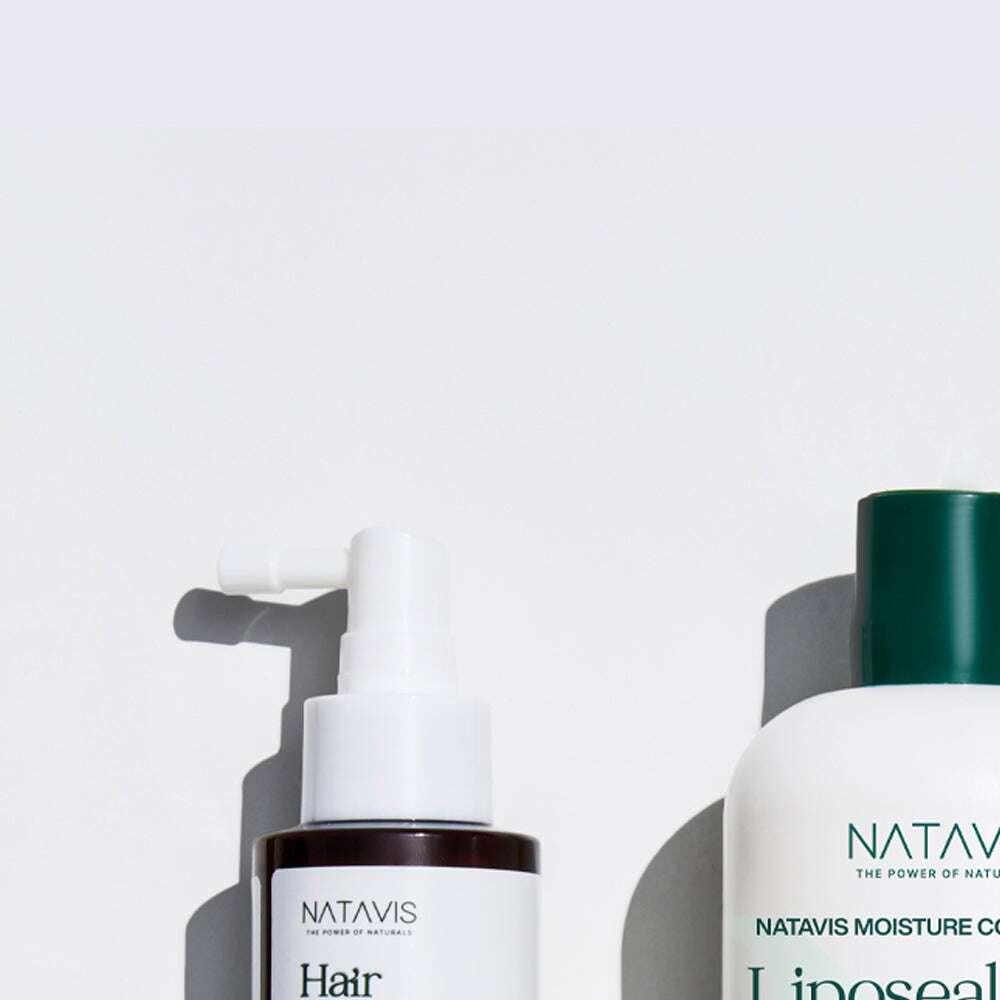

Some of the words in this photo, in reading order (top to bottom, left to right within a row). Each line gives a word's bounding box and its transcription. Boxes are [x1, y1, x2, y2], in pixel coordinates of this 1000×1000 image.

[856, 868, 882, 879] THE
[888, 868, 937, 879] POWER
[942, 868, 960, 879] OF
[302, 900, 418, 924] NATAVIS
[756, 918, 848, 936] NATAVIS
[854, 918, 972, 936] MOISTURE
[300, 963, 382, 998] Hair
